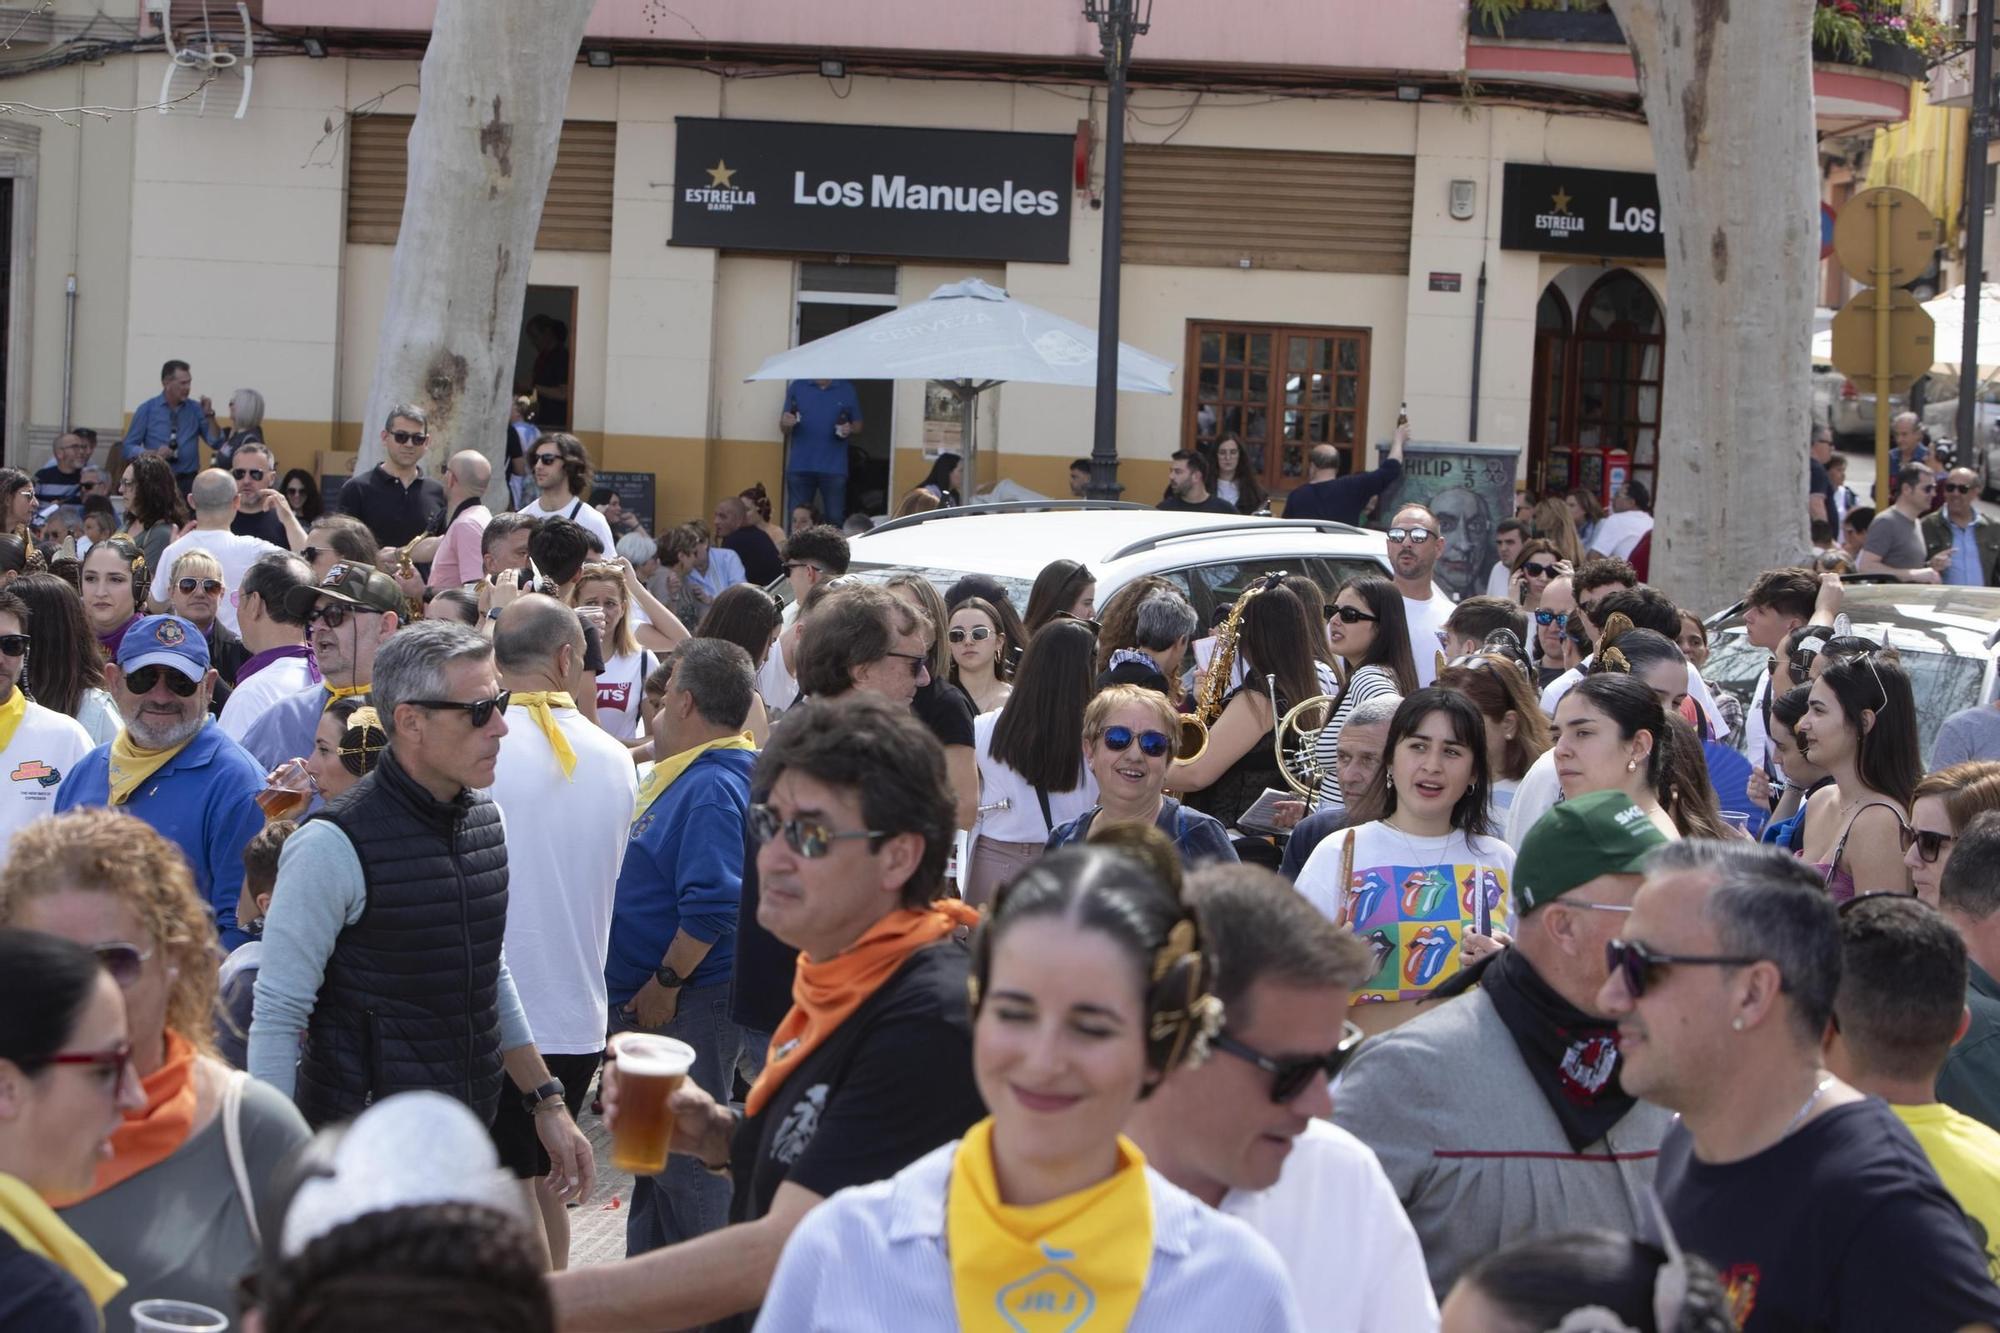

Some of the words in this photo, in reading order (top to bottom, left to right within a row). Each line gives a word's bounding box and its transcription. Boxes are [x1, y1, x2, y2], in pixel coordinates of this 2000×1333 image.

[685, 188, 756, 205] ESTRELLA
[794, 171, 864, 207] Los
[871, 174, 1059, 216] Manueles
[1536, 214, 1584, 231] ESTRELLA
[1609, 197, 1656, 233] Los
[869, 312, 993, 343] CERVEZA
[1405, 459, 1452, 477] HILIP
[597, 689, 625, 701] VI'S
